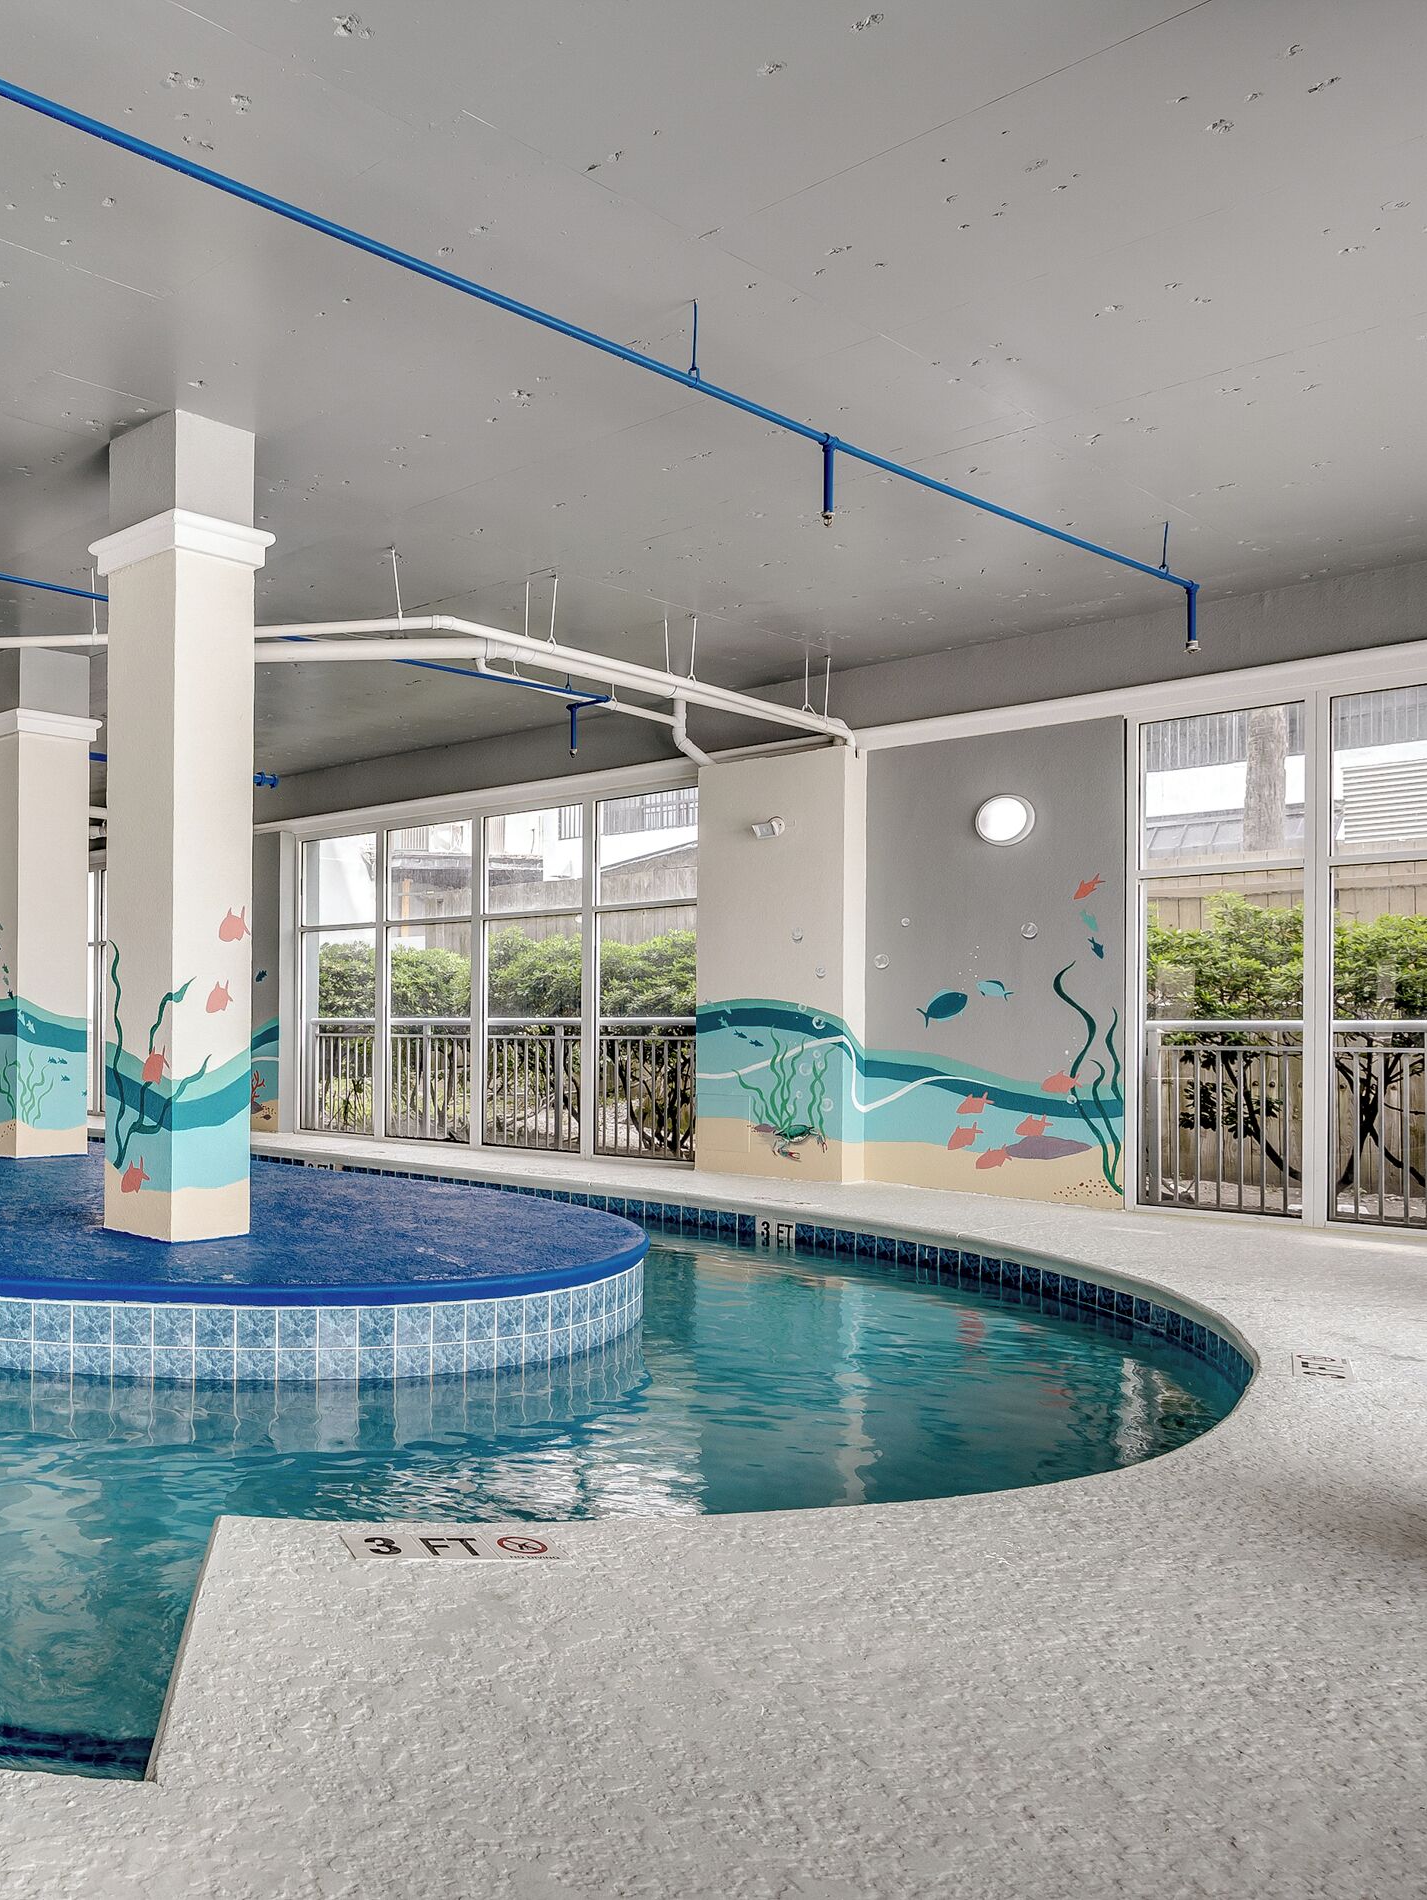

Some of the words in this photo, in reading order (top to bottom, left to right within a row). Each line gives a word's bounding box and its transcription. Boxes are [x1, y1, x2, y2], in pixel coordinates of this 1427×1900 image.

[776, 1222, 794, 1244] FT
[363, 1537, 402, 1556] 3
[418, 1537, 481, 1557] FT
